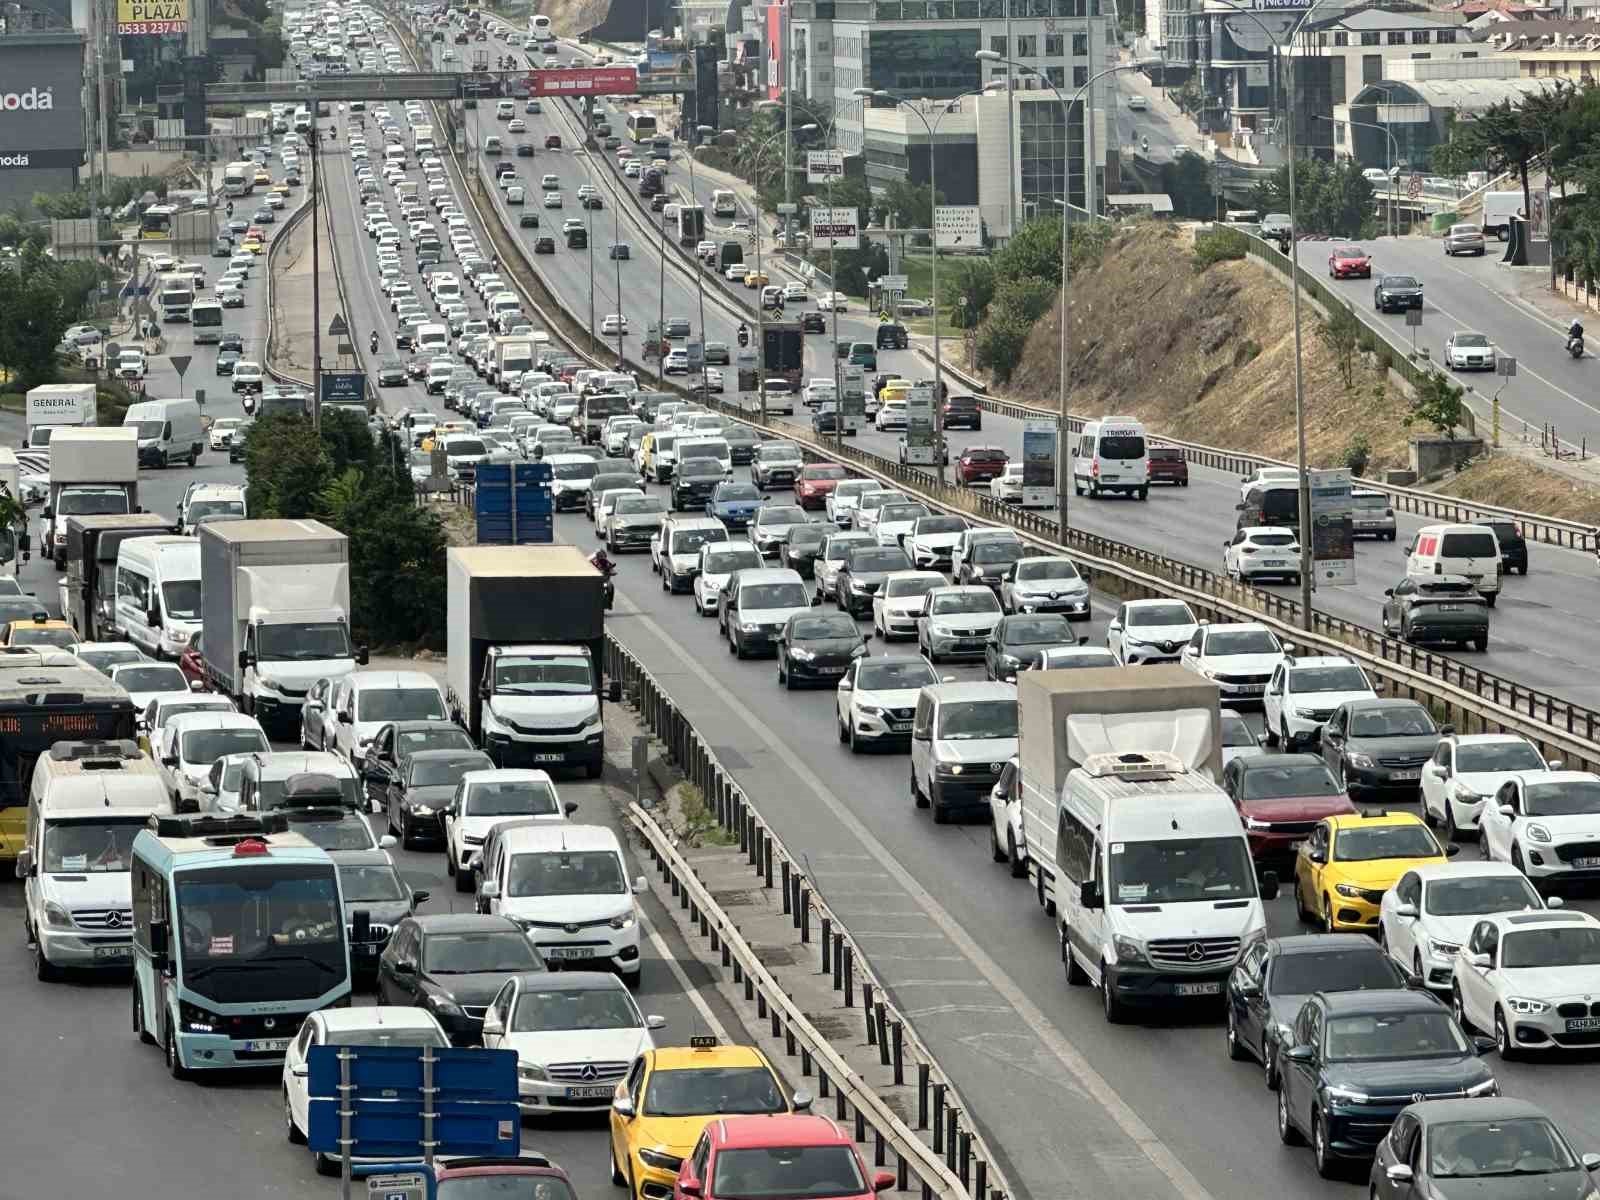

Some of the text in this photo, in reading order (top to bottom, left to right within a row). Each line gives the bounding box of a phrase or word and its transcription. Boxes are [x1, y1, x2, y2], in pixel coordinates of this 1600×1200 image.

[132, 4, 181, 20] PLAZA
[118, 22, 147, 34] 0533
[149, 22, 169, 33] 237
[33, 399, 77, 407] GENERAL
